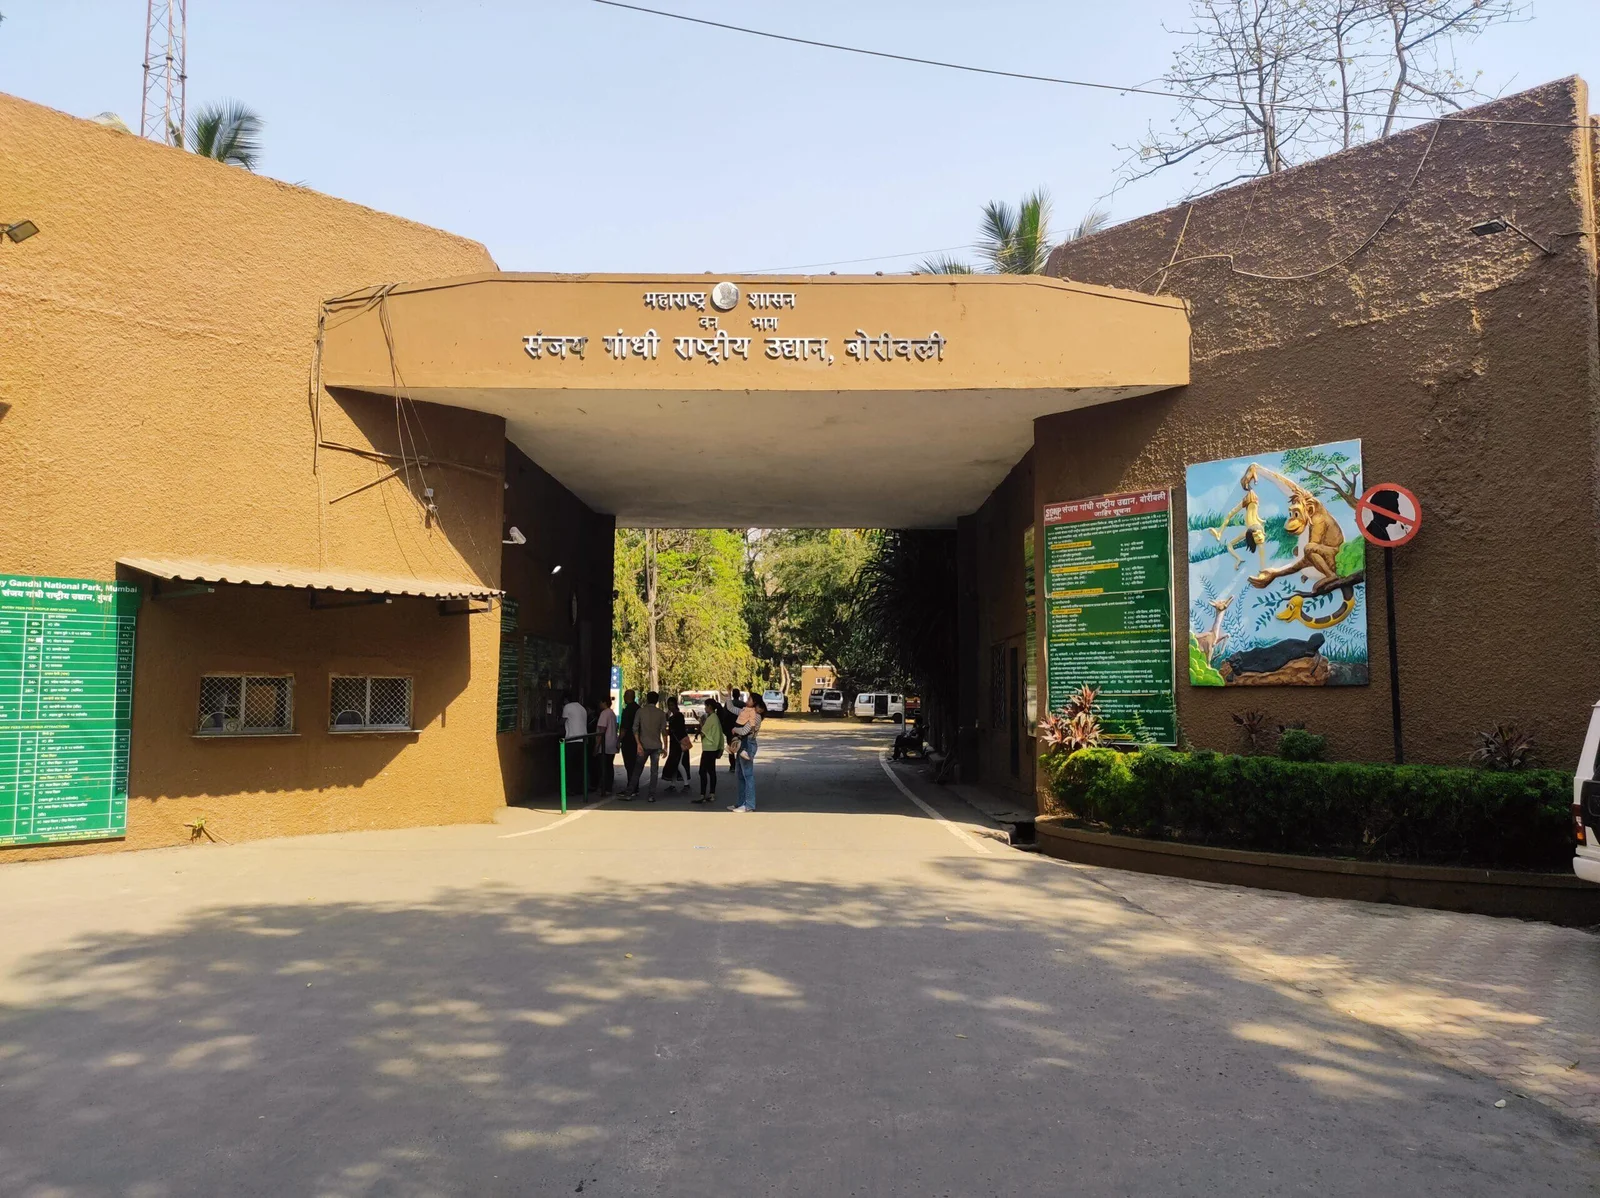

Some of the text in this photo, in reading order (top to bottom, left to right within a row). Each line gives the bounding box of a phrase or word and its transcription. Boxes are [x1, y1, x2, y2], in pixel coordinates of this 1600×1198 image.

[644, 292, 796, 309] महाराष्ट्र शासन
[699, 316, 778, 330] वन भाग
[524, 328, 947, 365] संजय गांधी राष्ट्रीय उद्यान, बोरीवली
[9, 579, 42, 588] Gandhi
[44, 581, 79, 590] National
[82, 583, 104, 592] Park,
[105, 585, 138, 593] Mumbai
[1, 589, 24, 598] संजय
